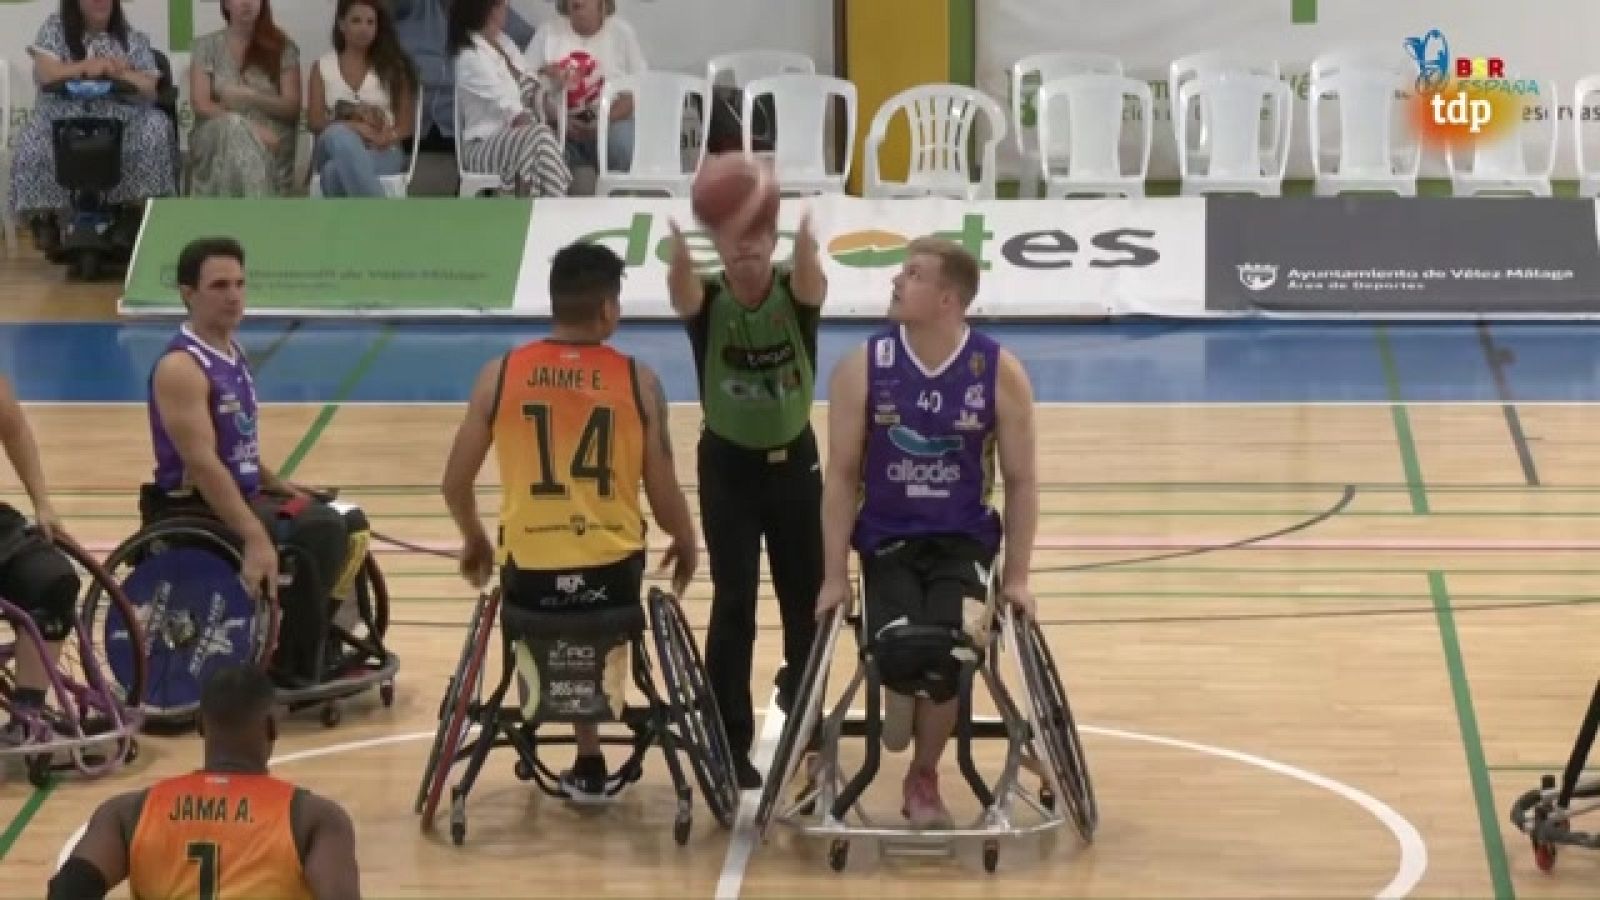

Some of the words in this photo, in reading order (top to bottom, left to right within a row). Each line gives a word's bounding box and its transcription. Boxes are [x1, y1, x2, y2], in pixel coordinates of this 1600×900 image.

[1287, 268, 1419, 281] Ayuntamiento
[1422, 268, 1446, 279] de
[1506, 267, 1575, 281] Málaga
[527, 366, 584, 388] JAIME
[591, 369, 608, 391] E.
[916, 389, 943, 413] 40
[521, 403, 616, 498] 14
[168, 794, 228, 822] JAMA
[234, 796, 256, 823] A.
